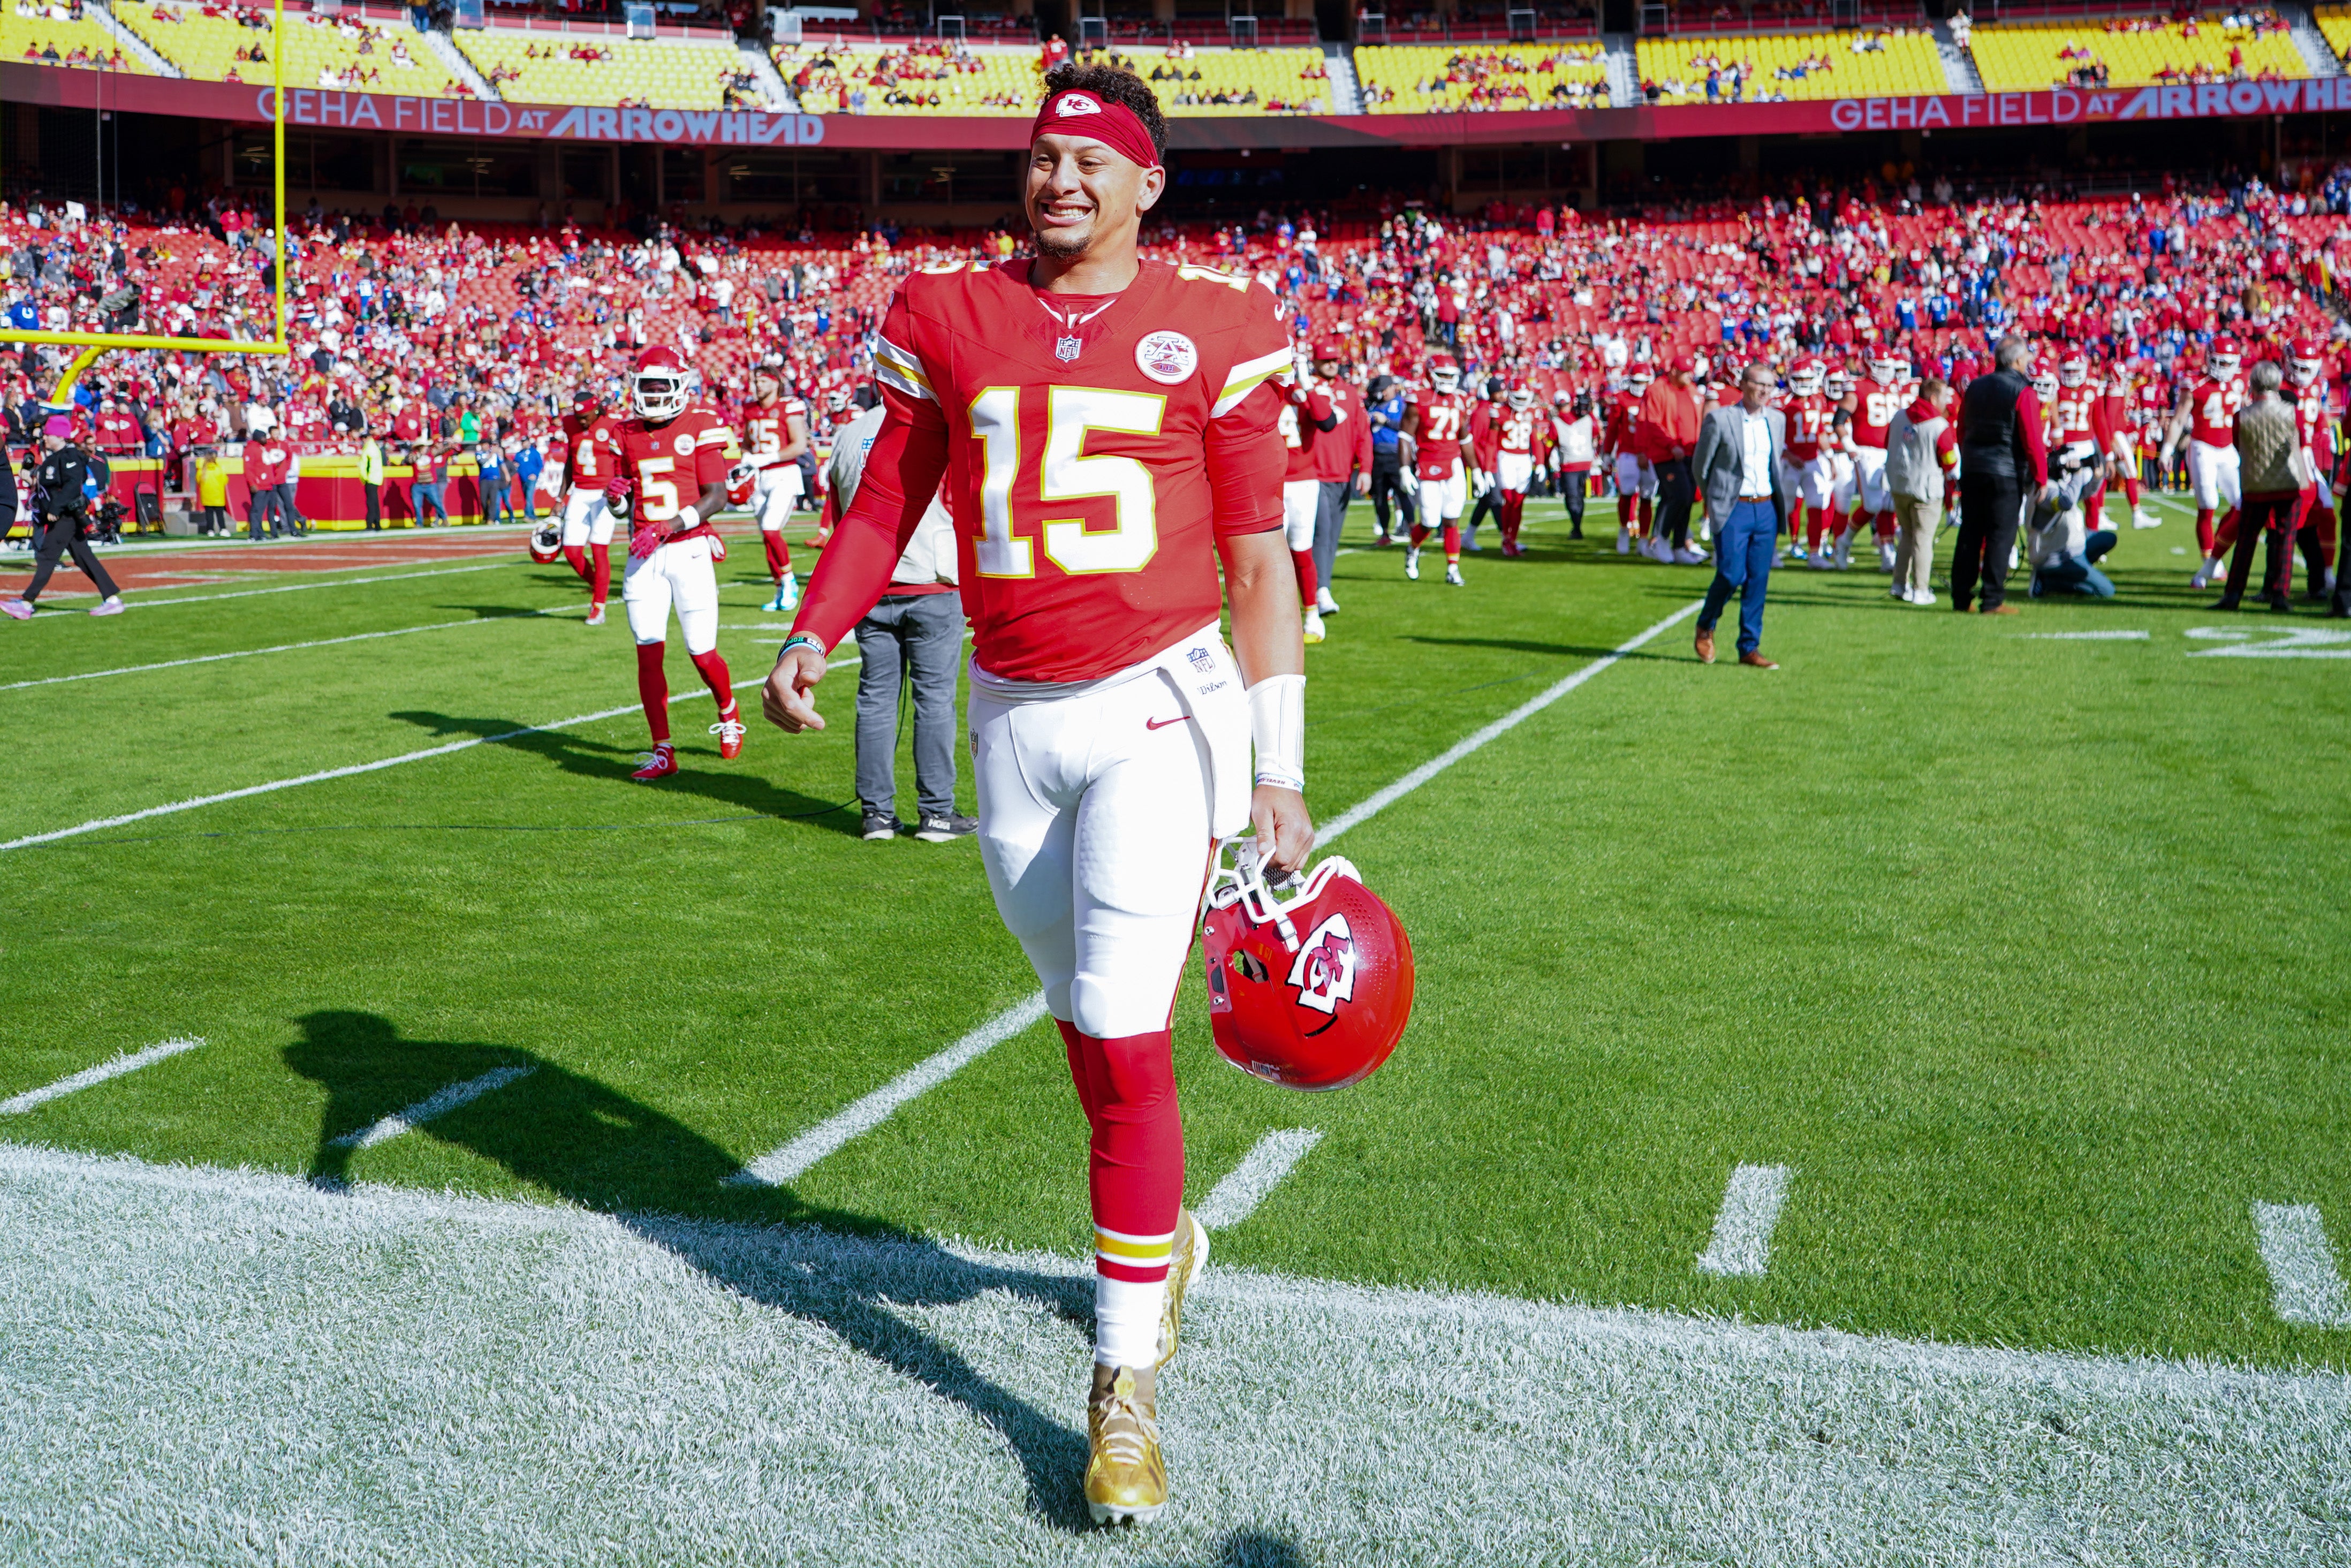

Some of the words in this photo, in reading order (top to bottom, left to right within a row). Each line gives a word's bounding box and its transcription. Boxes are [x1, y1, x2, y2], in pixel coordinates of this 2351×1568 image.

[257, 87, 382, 127] GEHA
[395, 96, 511, 134] FIELD
[517, 111, 551, 130] AT
[548, 107, 824, 145] ARROWHEAD
[1066, 99, 1090, 111] KC
[1830, 96, 1951, 131] GEHA
[1963, 89, 2081, 125] FIELD
[2088, 93, 2121, 115] AT
[1059, 347, 1075, 357] NFL
[1428, 406, 1459, 441] 71
[1793, 410, 1820, 444] 17
[577, 439, 597, 476] 4
[638, 456, 679, 521] 5
[967, 384, 1168, 578] 15
[1193, 658, 1213, 673] NFL
[1197, 681, 1227, 695] Wilson
[1302, 931, 1350, 997] KC
